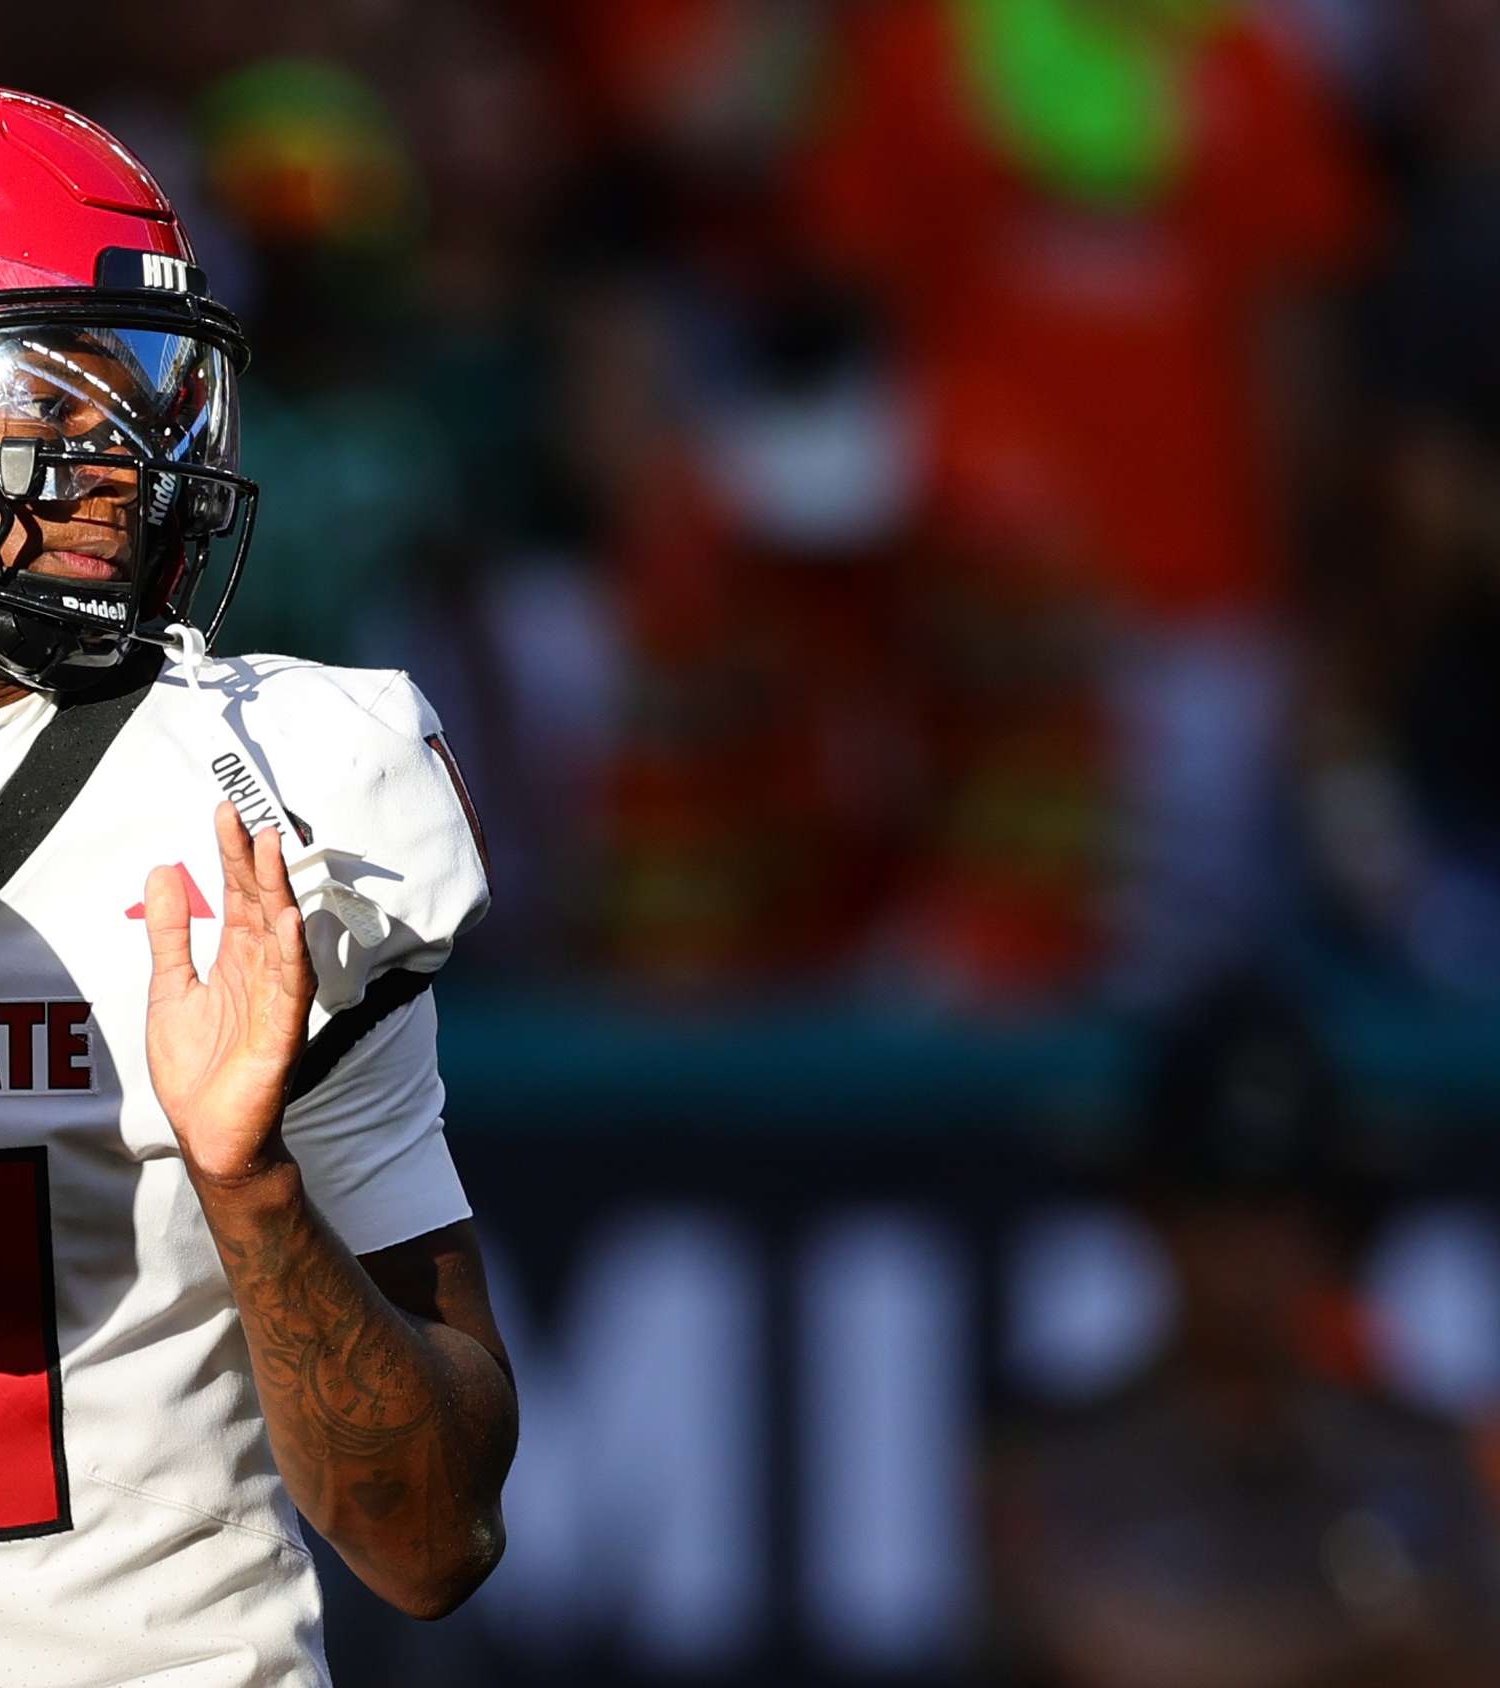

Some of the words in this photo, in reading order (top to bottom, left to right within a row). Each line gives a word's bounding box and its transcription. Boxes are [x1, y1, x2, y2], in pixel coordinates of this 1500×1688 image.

[142, 253, 188, 292] HTT
[147, 471, 177, 527] Ridd
[211, 752, 286, 838] XTRND
